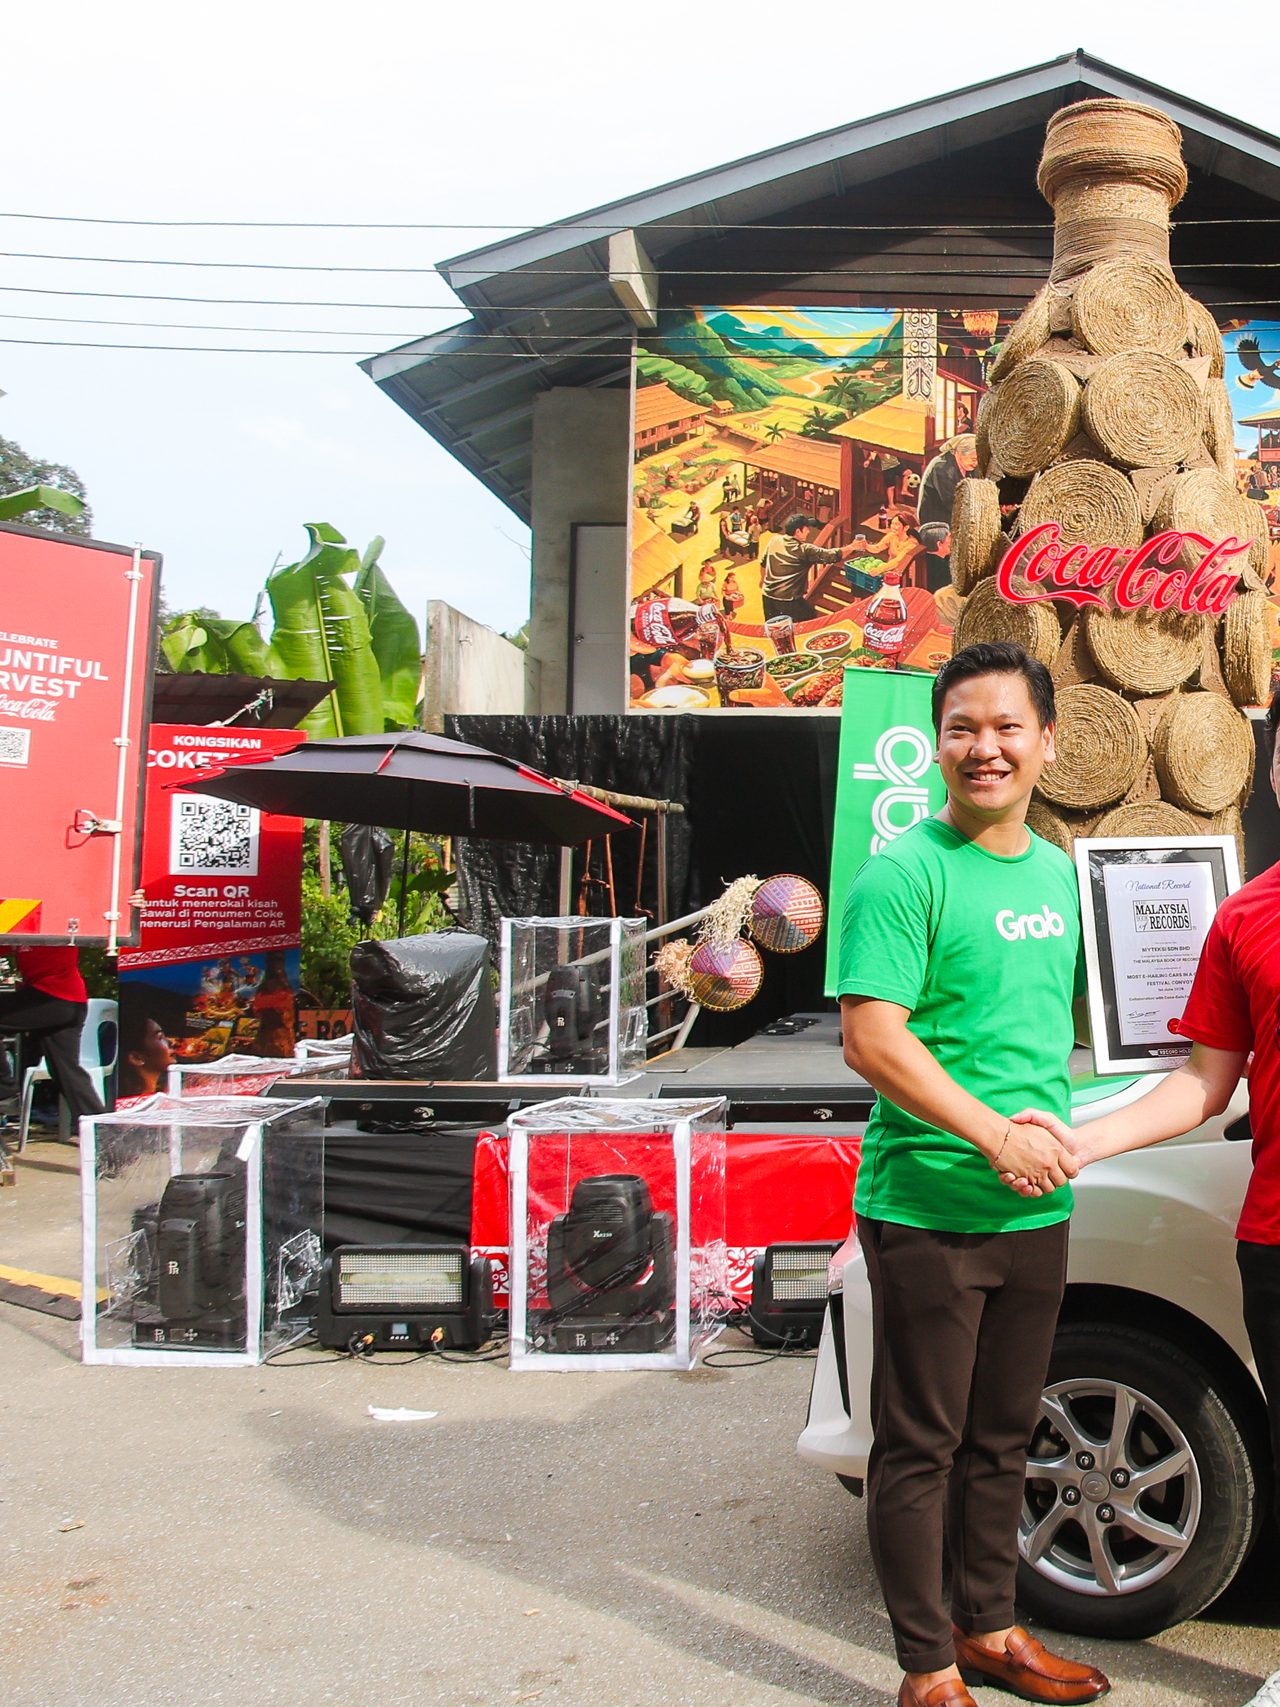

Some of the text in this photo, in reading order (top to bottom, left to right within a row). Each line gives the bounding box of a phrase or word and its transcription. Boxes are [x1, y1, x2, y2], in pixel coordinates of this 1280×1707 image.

[995, 519, 1256, 616] Coca-Cola
[173, 735, 262, 749] KONGSIKAN
[174, 885, 250, 898] Scan QR
[144, 899, 278, 908] untuk menerokai kisah
[1136, 903, 1188, 915] MALAYSIA
[178, 909, 190, 918] di
[193, 910, 251, 918] monumen
[254, 909, 284, 918] Coke
[194, 920, 267, 929] Pengalaman
[269, 920, 286, 928] AR
[995, 904, 1065, 941] Grab
[1150, 915, 1190, 930] RECORDS
